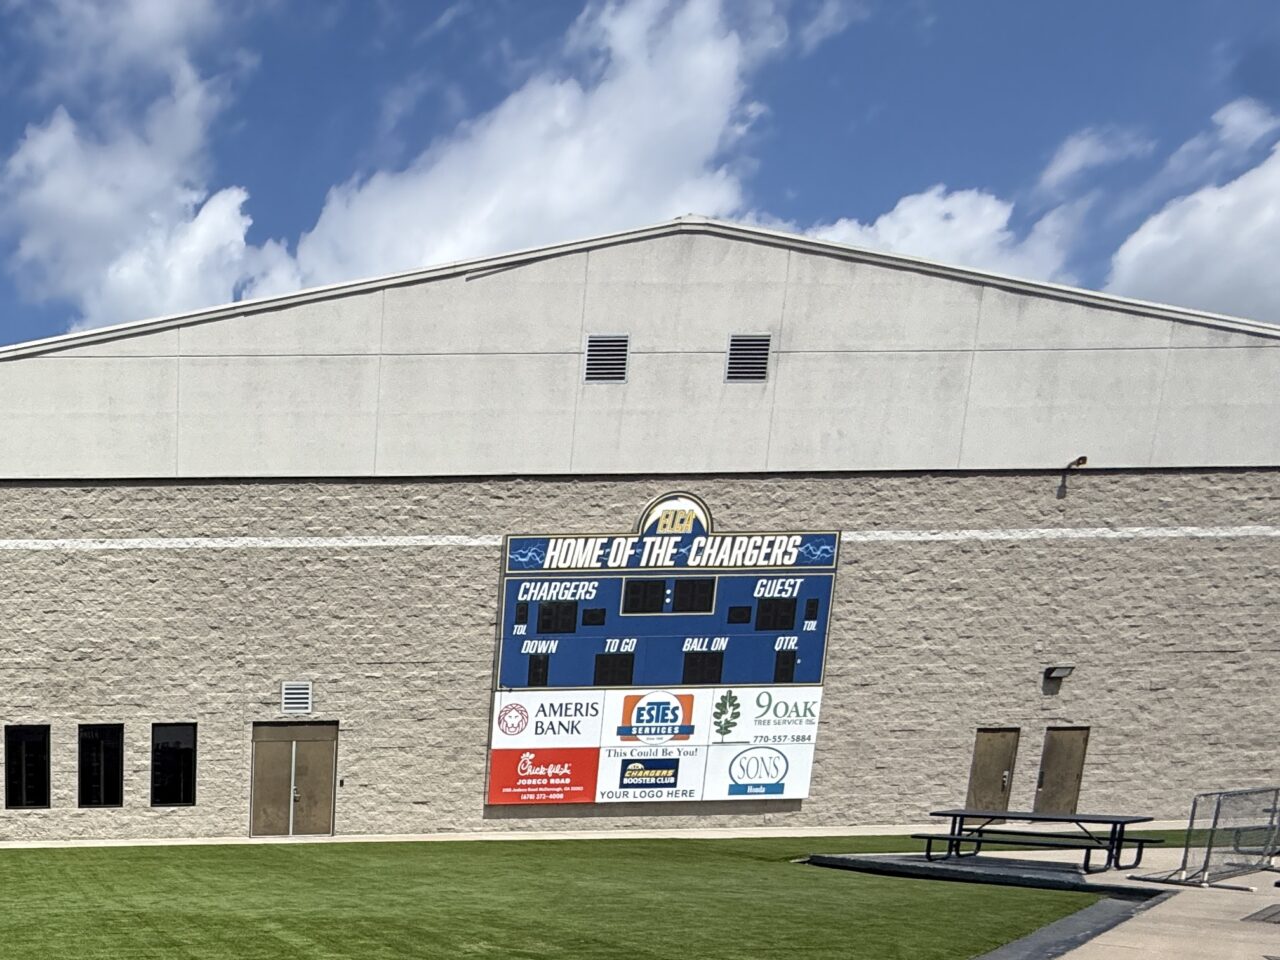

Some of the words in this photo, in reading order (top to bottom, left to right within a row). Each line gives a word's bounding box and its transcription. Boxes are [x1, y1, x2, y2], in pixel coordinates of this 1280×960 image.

[656, 509, 696, 534] ELCA
[543, 537, 608, 569] HOME
[607, 537, 639, 568] OF
[640, 536, 682, 567] THE
[687, 535, 802, 567] CHARGERS
[517, 581, 599, 601] CHARGERS
[753, 578, 805, 598] GUEST
[512, 624, 527, 635] TOL
[803, 620, 818, 631] TOL
[520, 640, 559, 654] DOWN
[604, 638, 619, 653] TO
[620, 638, 637, 652] GO
[682, 638, 709, 652] BALL
[710, 637, 729, 651] ON
[774, 636, 798, 651] QTR.
[535, 702, 599, 717] AMERIS
[635, 701, 680, 724] ESTES
[754, 691, 772, 719] 9
[773, 701, 818, 718] OAK
[534, 720, 582, 735] BANK
[631, 726, 680, 734] SERVICES
[753, 734, 812, 743] 770-557-5884
[606, 748, 627, 758] This
[630, 748, 658, 757] Could
[661, 748, 674, 757] Be
[677, 748, 698, 757] You!
[517, 753, 571, 777] Chick-fil-A
[737, 756, 781, 780] SONS
[624, 769, 675, 777] CHARGERS
[600, 790, 629, 799] YOUR
[633, 790, 663, 798] LOGO
[666, 789, 695, 798] HERE
